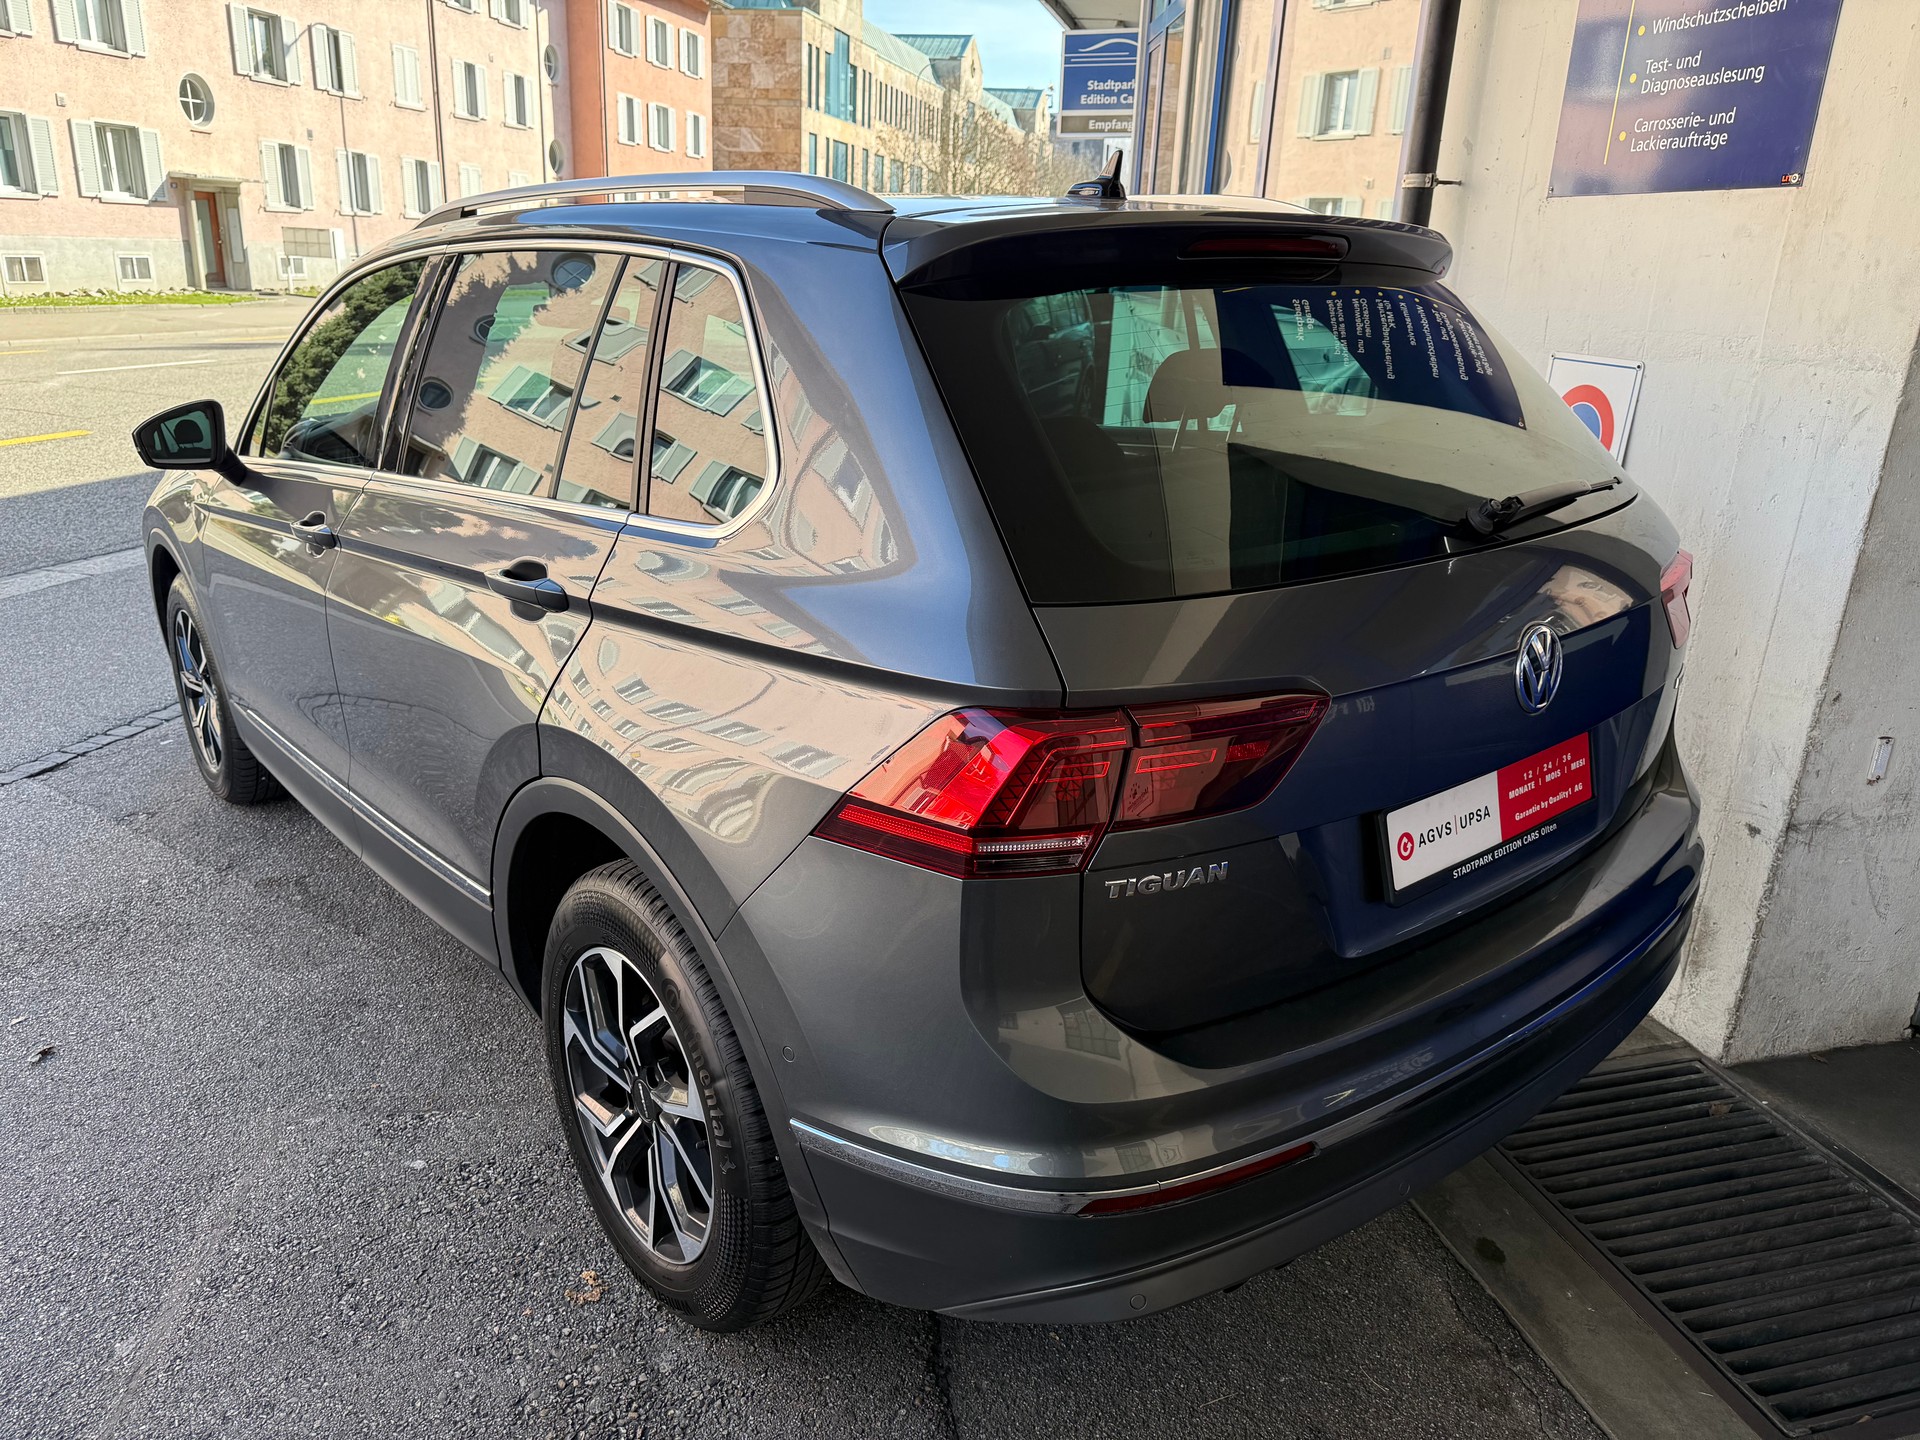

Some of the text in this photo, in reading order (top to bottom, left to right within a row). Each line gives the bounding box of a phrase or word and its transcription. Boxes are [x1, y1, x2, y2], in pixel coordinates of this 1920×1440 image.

[1653, 0, 1788, 35] Windschutzscheiben
[1640, 64, 1766, 95] Diagnoseauslesung
[1645, 51, 1702, 75] Test- und
[1080, 94, 1117, 105] Edition
[1088, 119, 1134, 132] Empfang
[1634, 107, 1736, 133] Carrosserie- und
[1630, 131, 1728, 152] Lackieraufträge
[1508, 781, 1536, 799] MONATE
[1545, 769, 1561, 783] MOIS
[1570, 757, 1586, 771] MESI
[1515, 782, 1583, 821] Garantie by Quality1 AG
[1418, 805, 1491, 848] AGVS UPSA
[1452, 852, 1494, 879] STADTPARK
[1494, 839, 1522, 859] EDITION
[1523, 830, 1540, 845] CARS
[1105, 861, 1229, 899] TIGUAN
